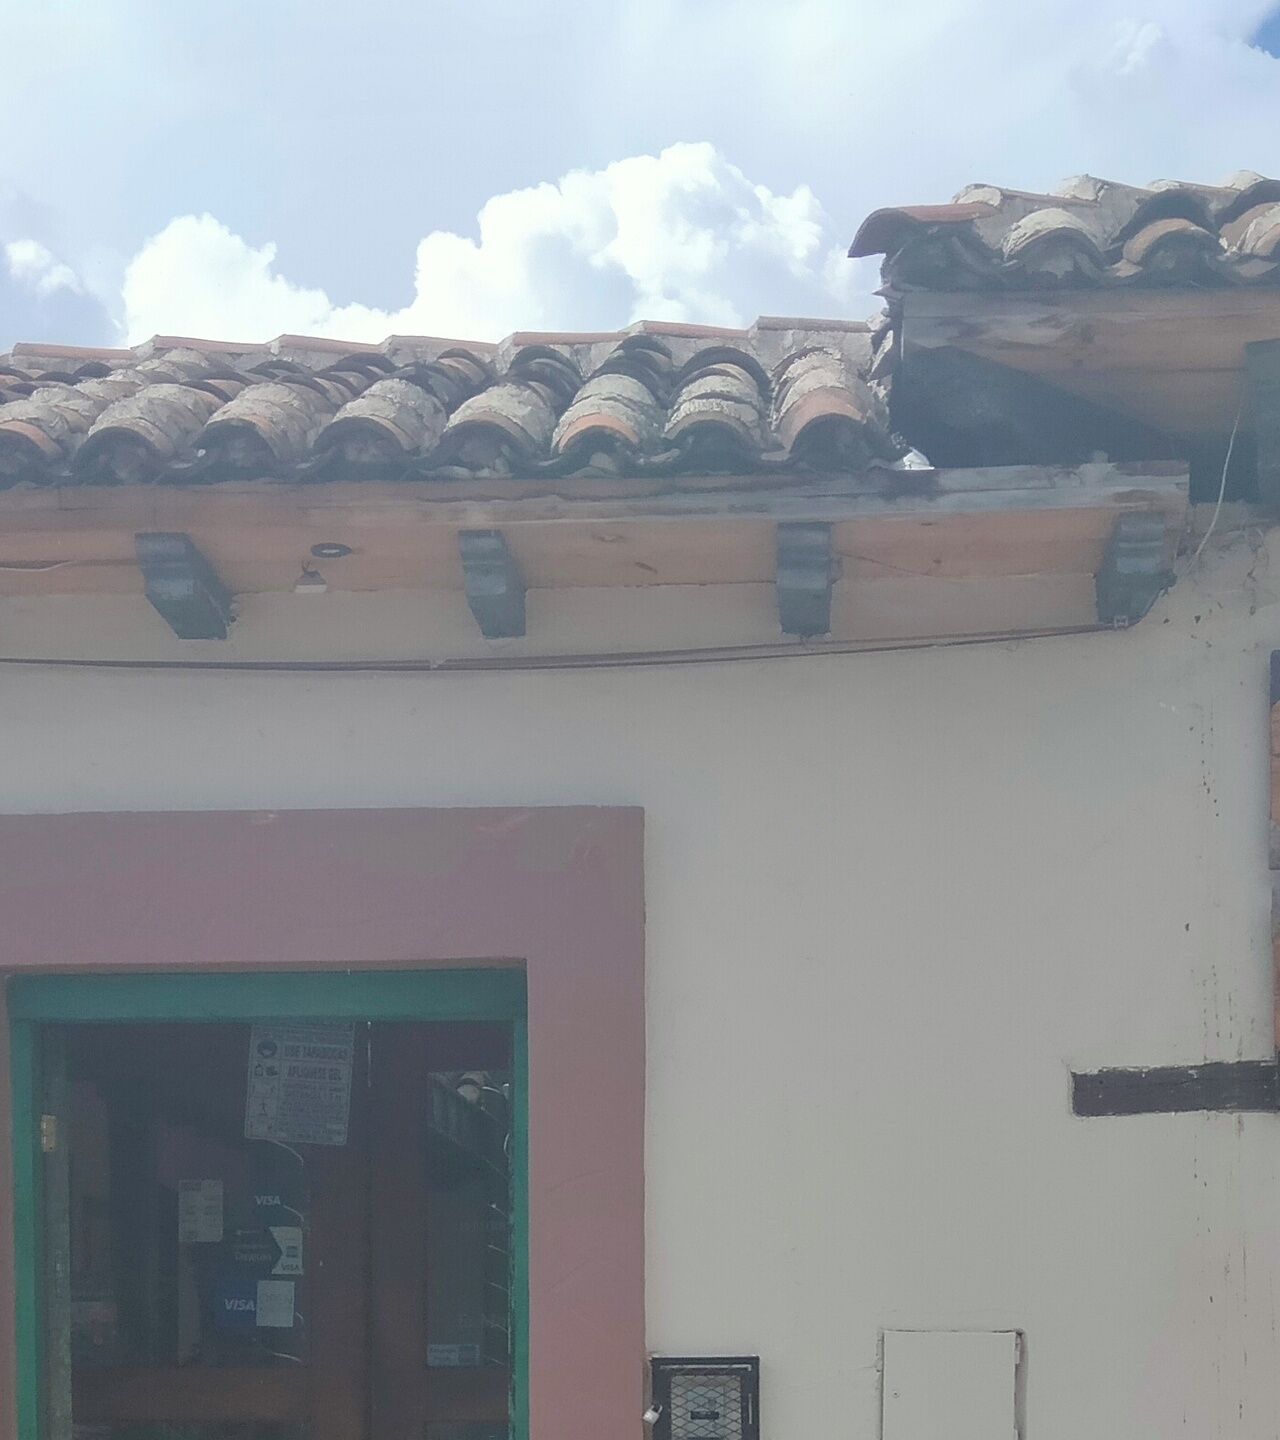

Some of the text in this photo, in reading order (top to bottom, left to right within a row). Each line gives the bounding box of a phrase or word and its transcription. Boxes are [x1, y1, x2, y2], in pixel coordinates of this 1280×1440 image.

[254, 1195, 281, 1206] VISA
[281, 1262, 300, 1271] VISA
[224, 1299, 256, 1311] VISA
